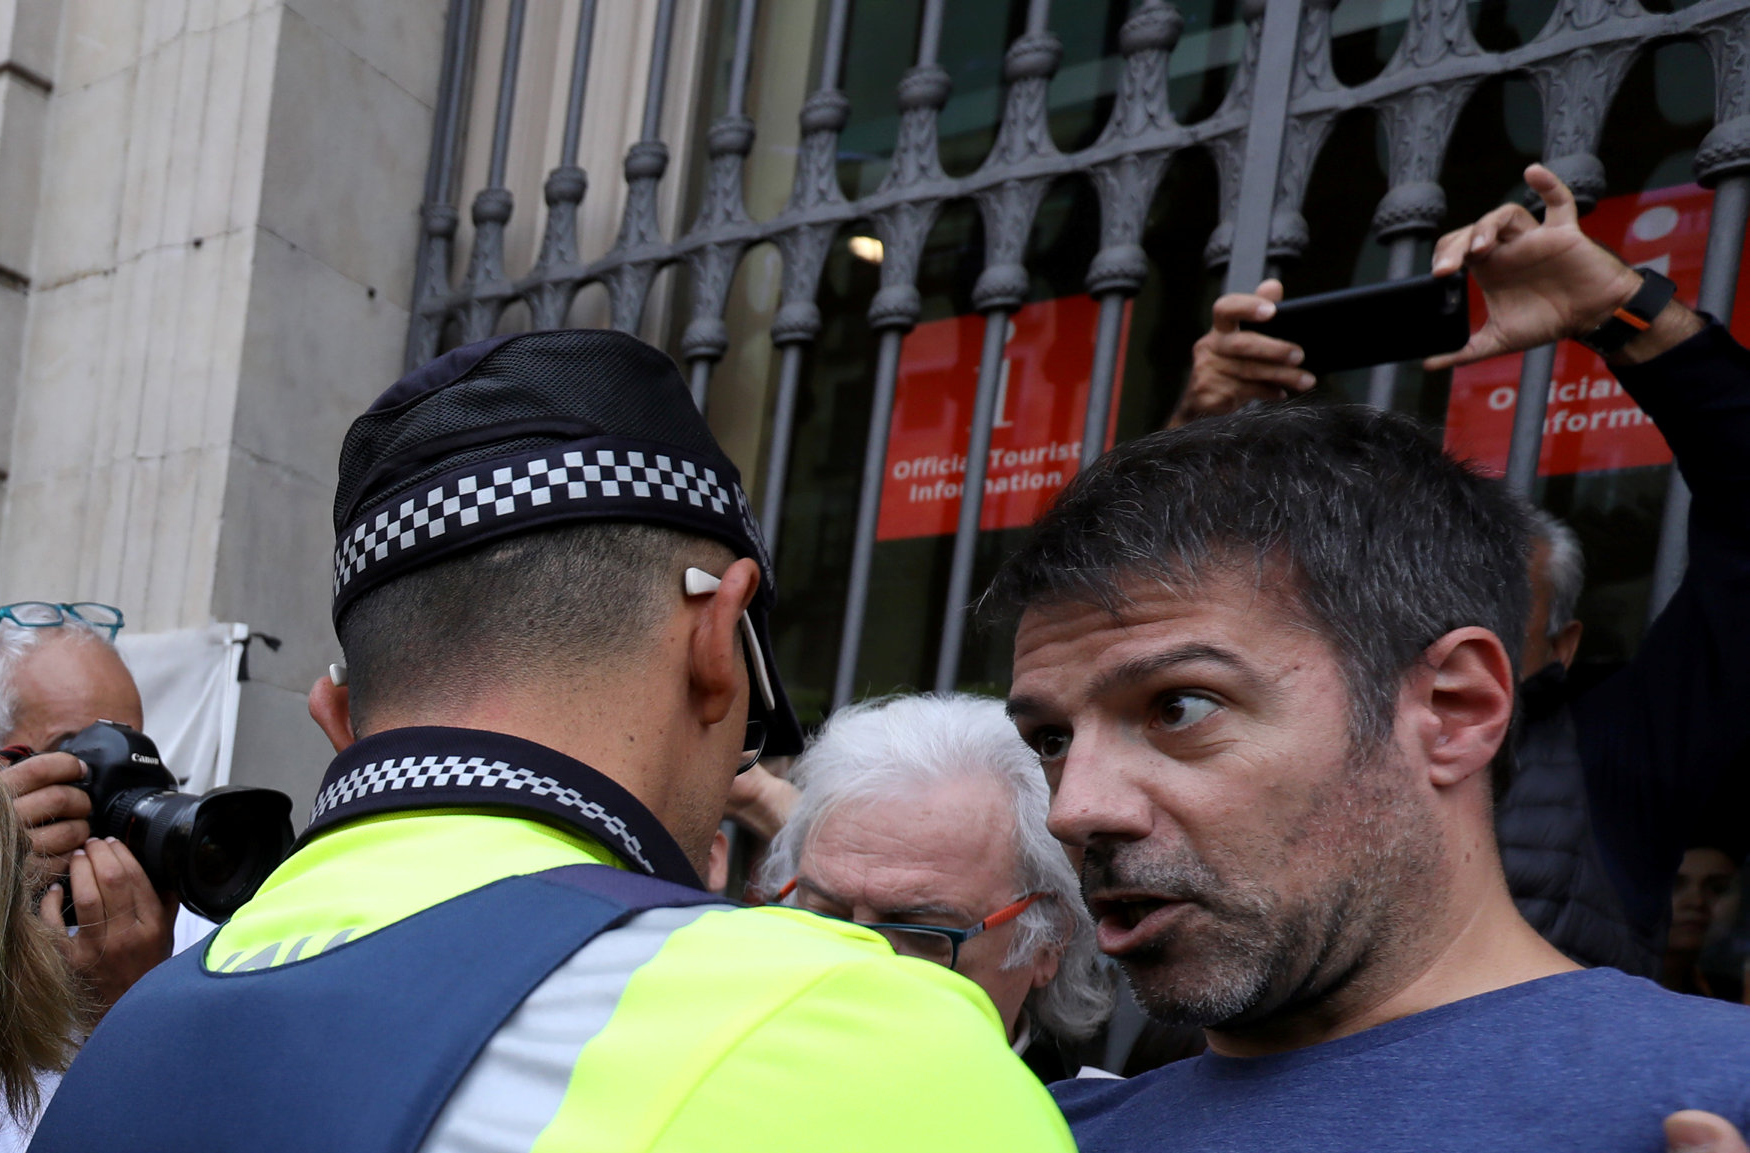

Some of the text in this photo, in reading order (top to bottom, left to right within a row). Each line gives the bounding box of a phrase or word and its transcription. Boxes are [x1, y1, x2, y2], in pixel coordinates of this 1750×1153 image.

[1487, 376, 1623, 411] Oicial
[1542, 407, 1654, 434] form
[893, 441, 1082, 480] Officia Tourist
[909, 470, 1062, 502] Infoation
[131, 752, 159, 766] Canon
